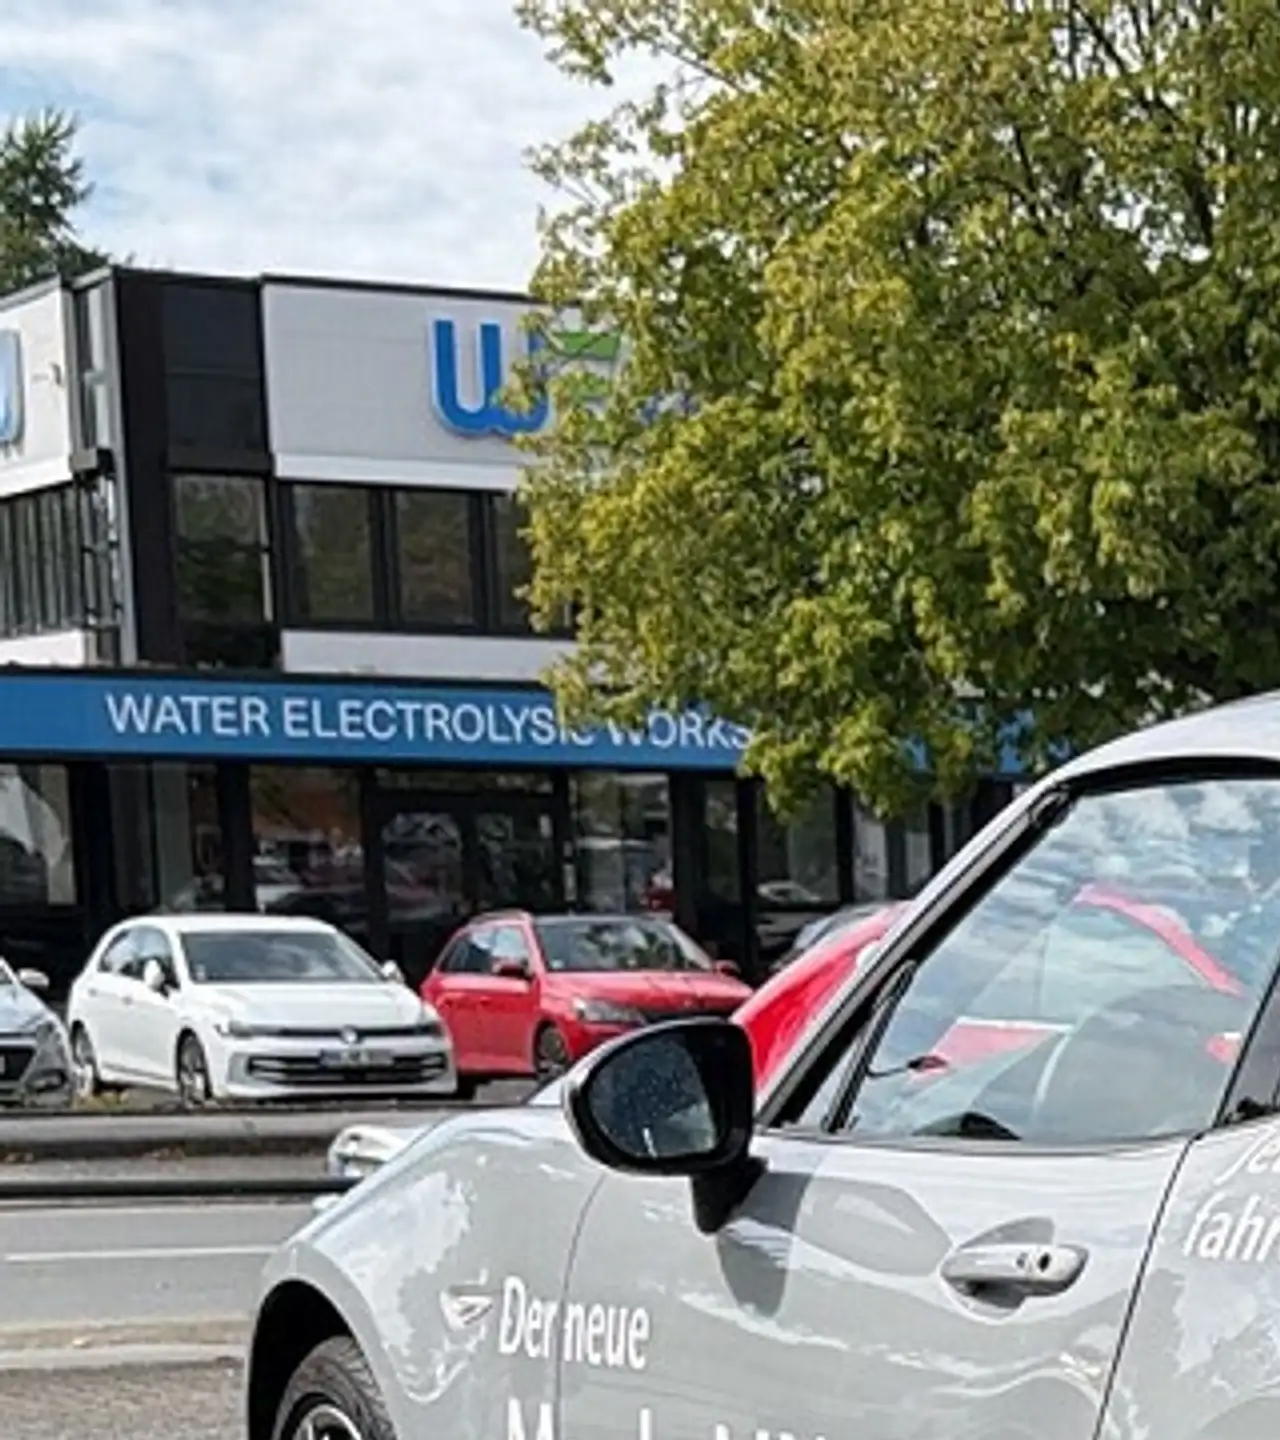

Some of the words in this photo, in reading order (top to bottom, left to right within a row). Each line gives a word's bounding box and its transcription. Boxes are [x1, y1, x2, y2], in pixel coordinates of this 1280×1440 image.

[105, 693, 271, 738] WATER
[500, 1275, 558, 1357] Der
[563, 1298, 650, 1370] neue
